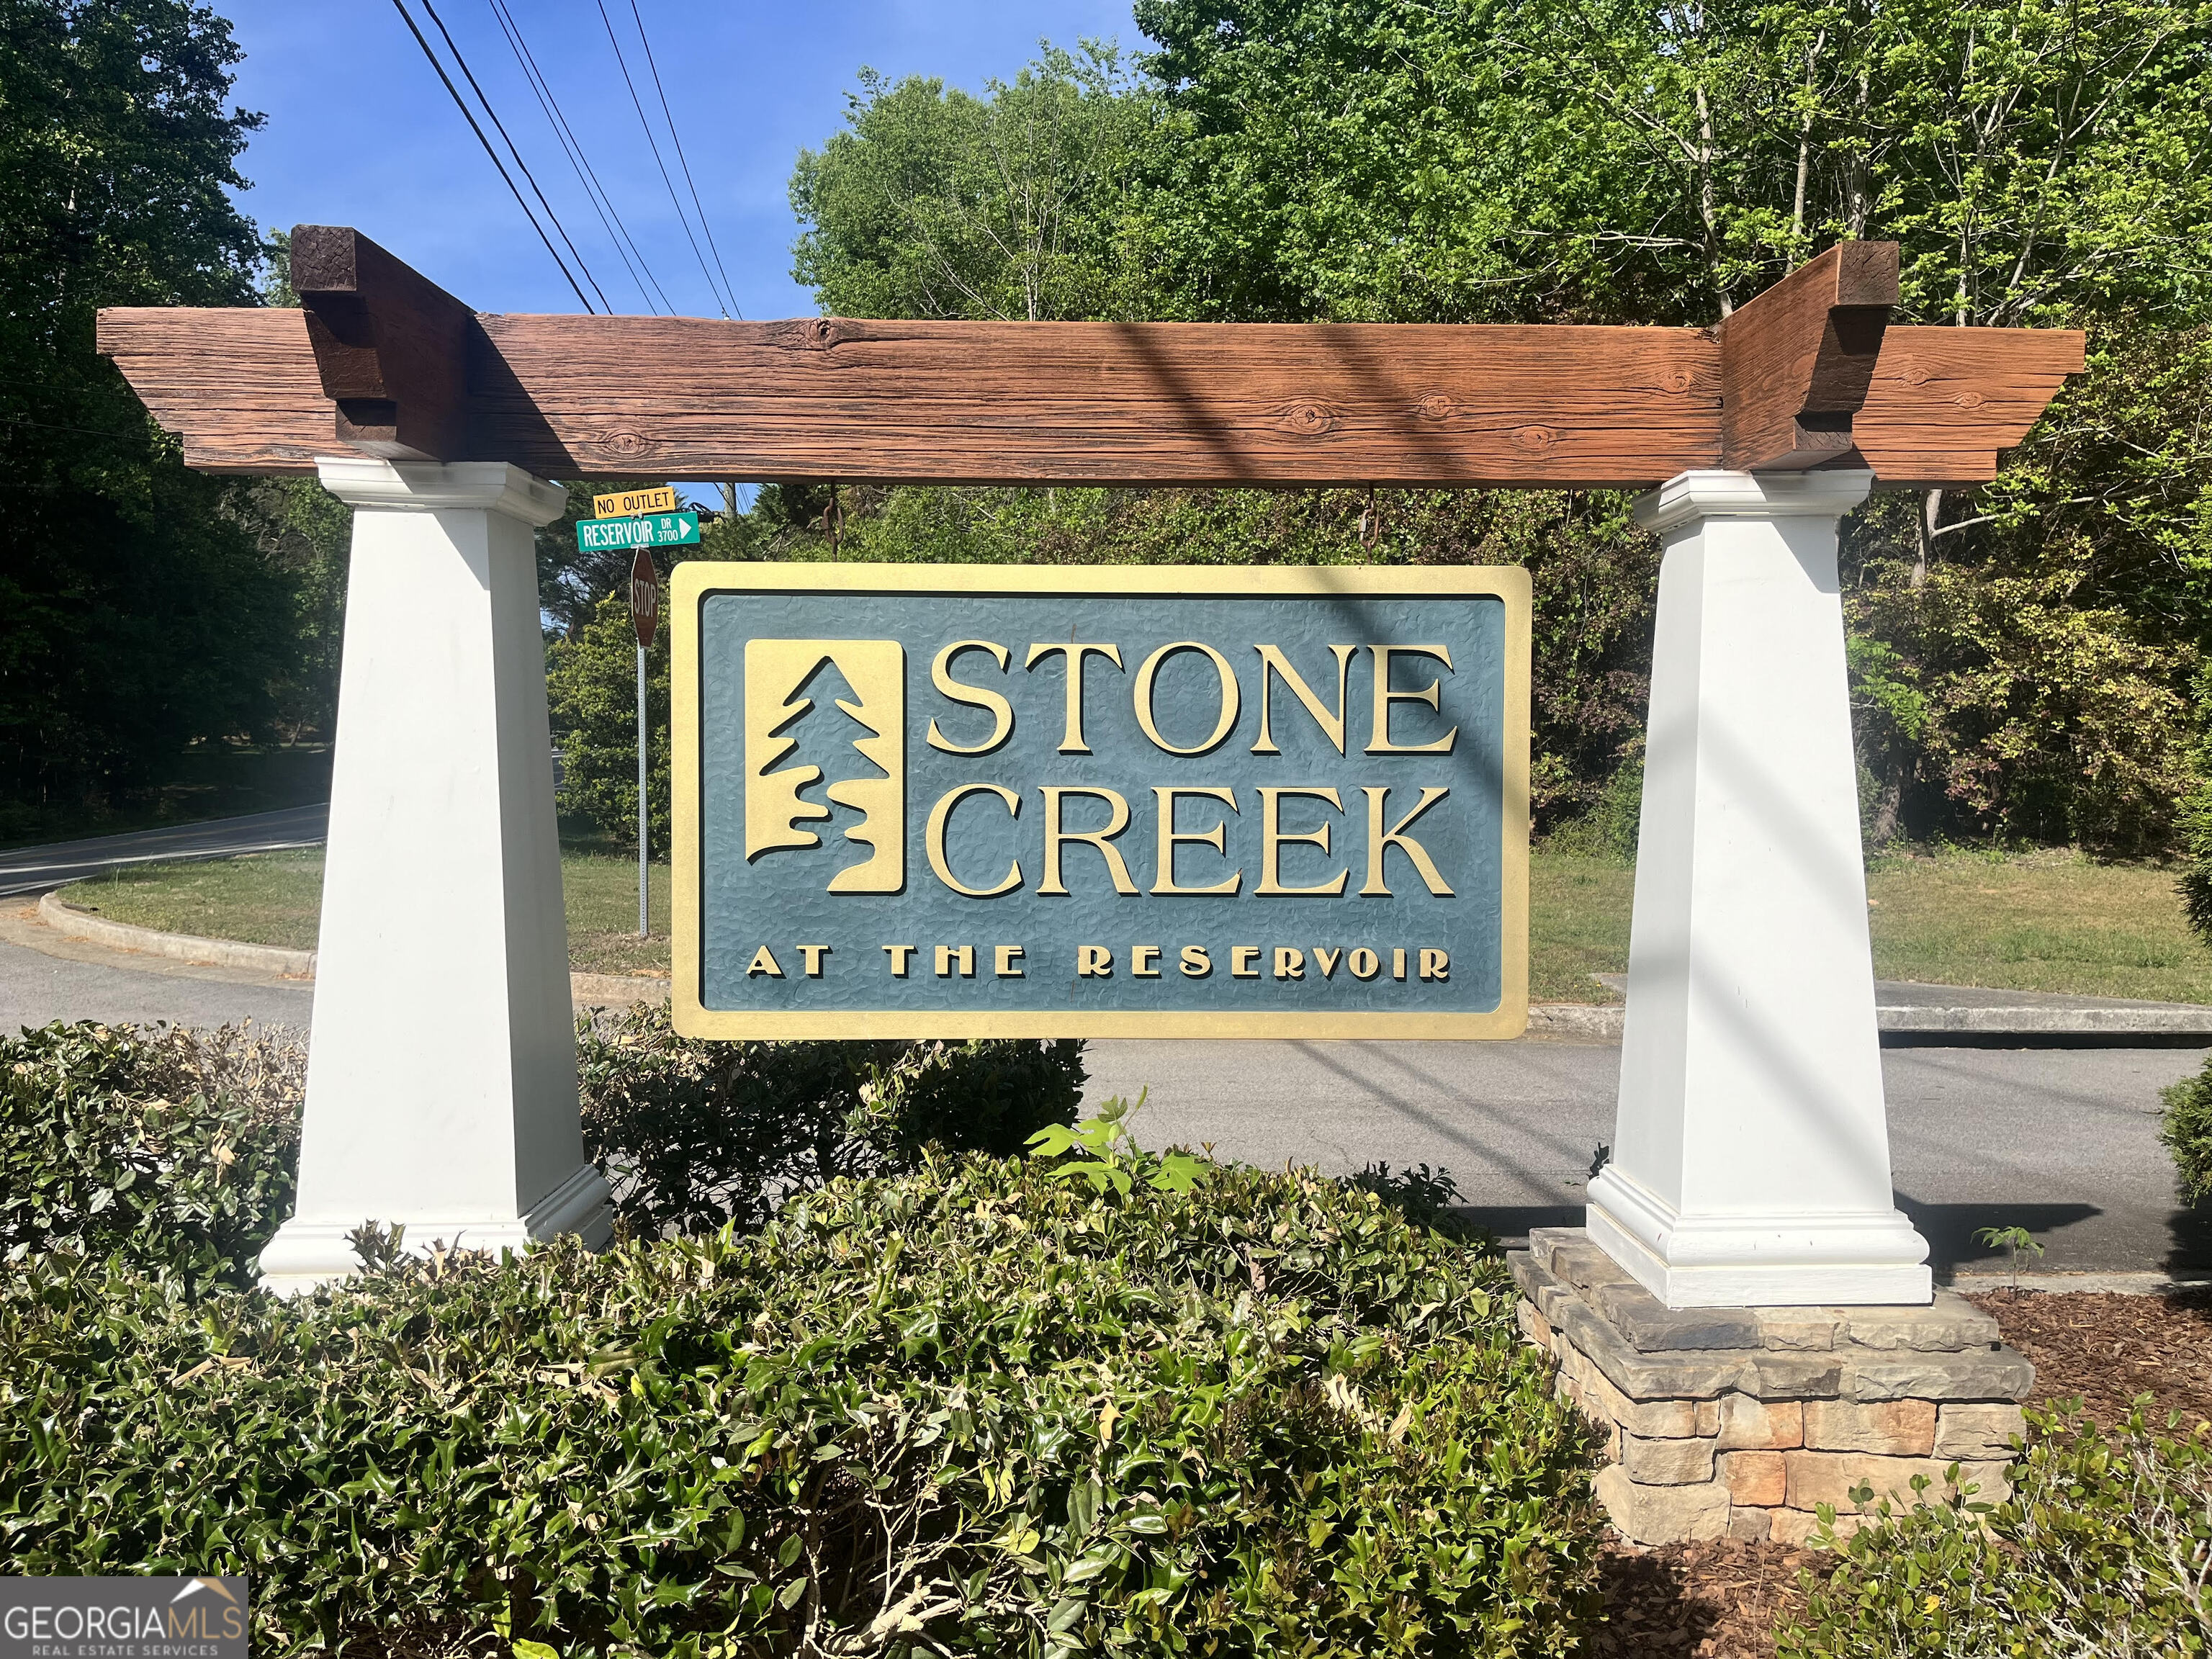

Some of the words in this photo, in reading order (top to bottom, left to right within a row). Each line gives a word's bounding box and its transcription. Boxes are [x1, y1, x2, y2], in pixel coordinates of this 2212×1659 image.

[597, 498, 615, 514] NO
[623, 492, 670, 511] OUTLET
[583, 521, 655, 547] RESERVOIR
[661, 518, 672, 529] DR
[657, 529, 678, 542] 3700
[634, 578, 656, 617] STOP
[926, 639, 1458, 757] STONE
[925, 783, 1456, 897] CREEK
[746, 945, 831, 977] AT
[882, 945, 1025, 977] THE
[1078, 945, 1452, 981] RESERVOIR
